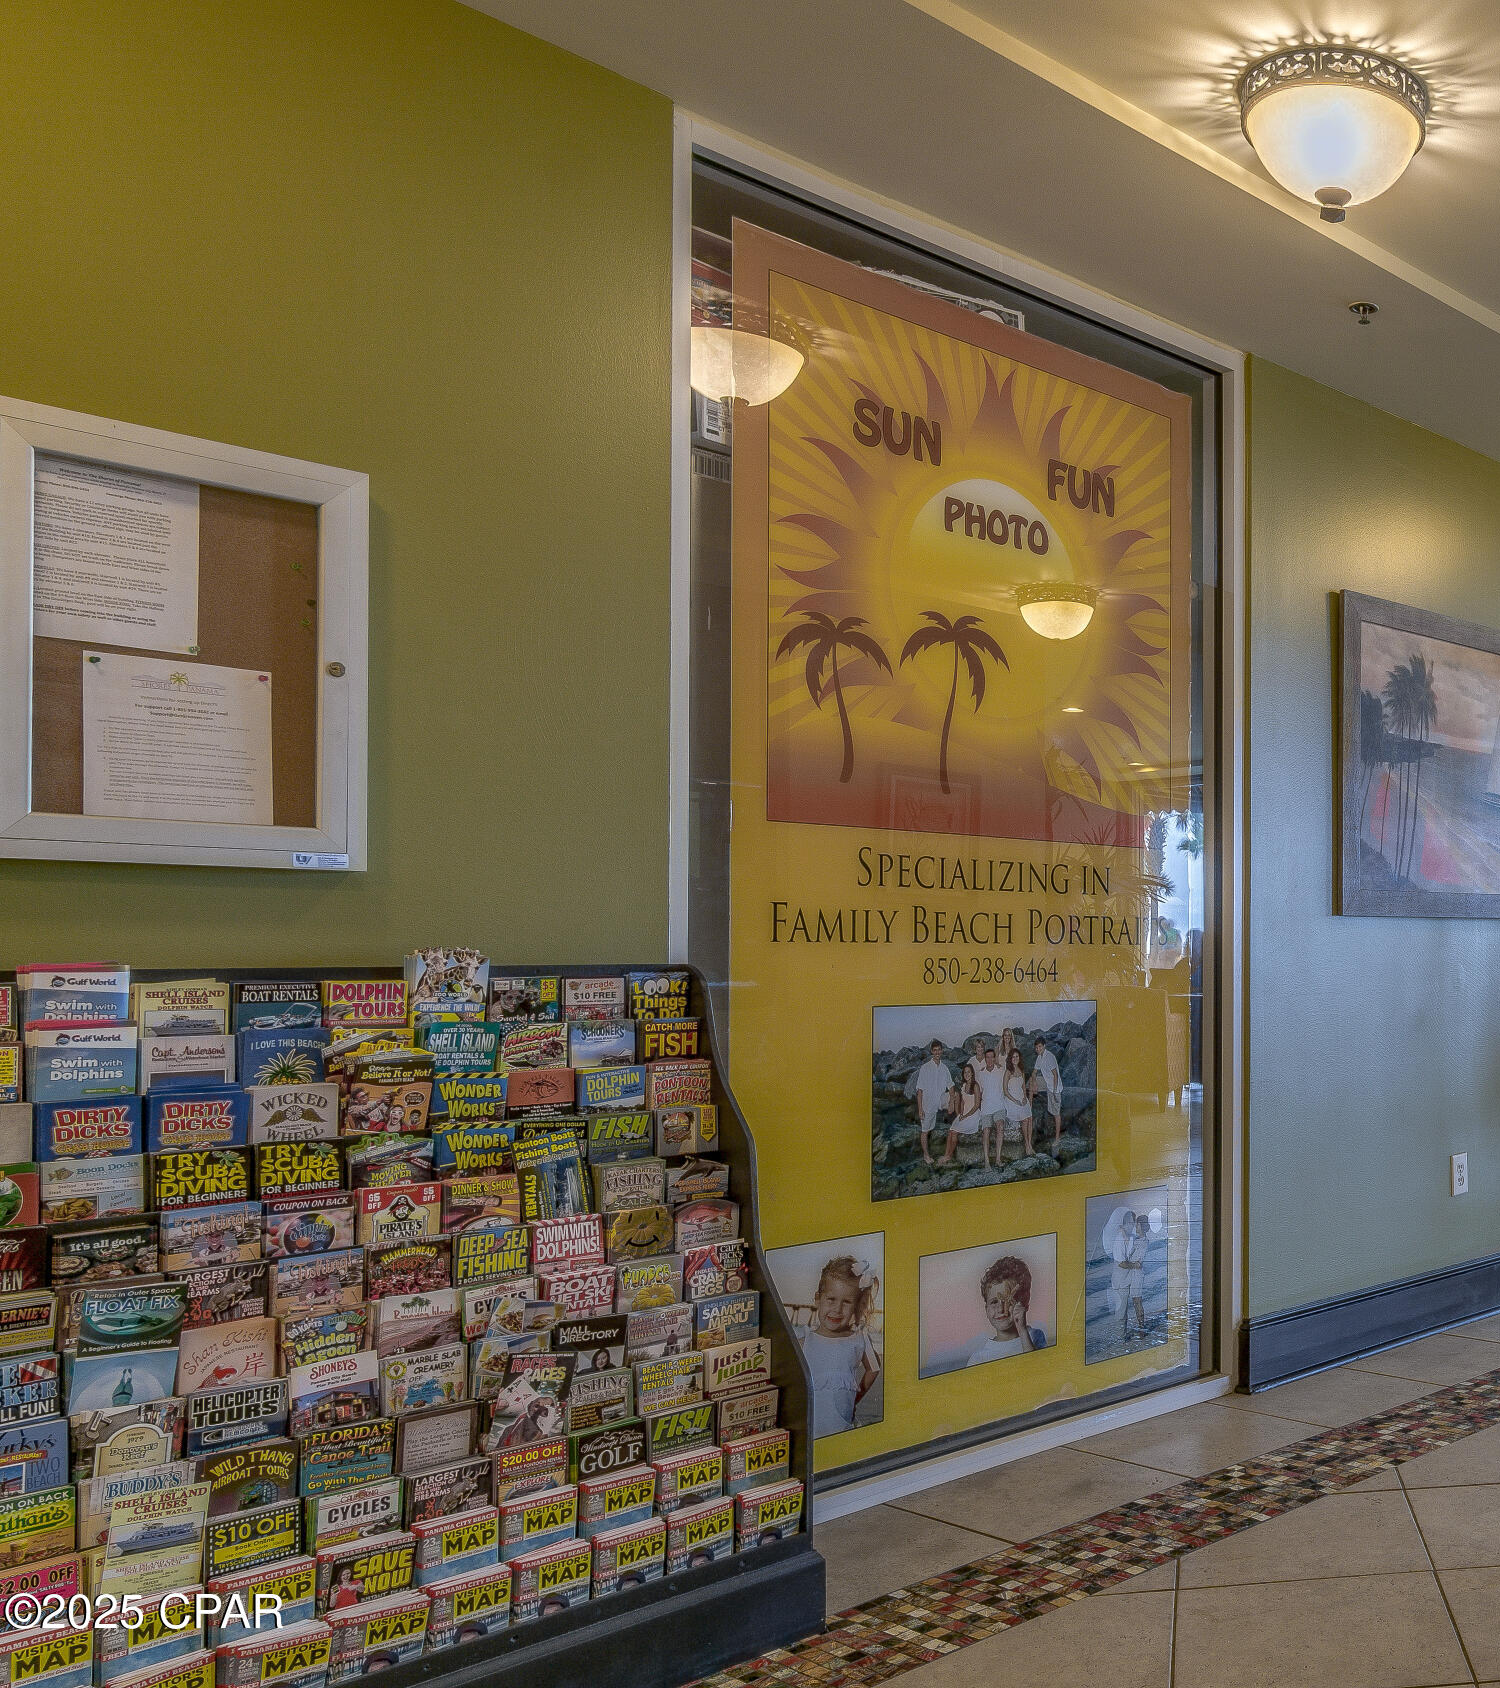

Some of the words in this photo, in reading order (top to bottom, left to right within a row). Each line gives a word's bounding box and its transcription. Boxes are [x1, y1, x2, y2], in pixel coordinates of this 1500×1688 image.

[852, 398, 943, 467] SUN
[1046, 458, 1117, 518] FUN
[943, 496, 1050, 556] PHOTO
[857, 846, 1070, 896] SPECIALIZING
[1081, 865, 1111, 897] IN
[770, 901, 899, 944] FAMILY
[911, 904, 1013, 946] BEACH
[1026, 908, 1168, 947] PORTRAITS
[922, 955, 1059, 985] 850-238-6464
[67, 978, 88, 986] Gulf
[88, 978, 117, 986] World
[332, 982, 406, 1001] DOLPHIN
[242, 991, 271, 1002] BOAT
[273, 990, 319, 1001] RENTALS
[352, 1001, 405, 1018] TOURS
[419, 1003, 452, 1012] EXPERIENCE
[453, 1003, 462, 1012] THE
[645, 1023, 673, 1032] CATCH
[674, 1022, 698, 1031] MORE
[255, 1040, 276, 1049] LOVE
[278, 1039, 295, 1048] THIS
[645, 1032, 698, 1057] FISH
[50, 1057, 98, 1068] Swim
[100, 1059, 123, 1067] with
[50, 1068, 124, 1082] Dolphins
[586, 1072, 640, 1091] DOLPHIN
[439, 1080, 502, 1101] WONDER
[587, 1087, 622, 1102] TOURS
[260, 1092, 328, 1112] WICKED
[447, 1100, 495, 1118] WORKS
[55, 1106, 129, 1127] DIRTY
[592, 1114, 650, 1140] FISH
[54, 1122, 131, 1143] DICKS
[513, 1137, 549, 1151] Pontoon
[550, 1130, 576, 1143] Boats
[161, 1151, 210, 1169] TRY
[515, 1148, 549, 1161] Fishing
[550, 1141, 577, 1152] Boats
[161, 1163, 247, 1183] SCUBA
[160, 1176, 247, 1198] DIVING
[161, 1196, 183, 1206] FOR
[187, 1190, 248, 1203] BEGINNERS
[273, 1200, 310, 1212] COUPON
[311, 1199, 323, 1209] ON
[325, 1197, 349, 1208] BACK
[379, 1219, 423, 1234] PIRATE'S
[383, 1230, 418, 1240] ISLAND
[536, 1225, 563, 1244] SWIM
[563, 1221, 600, 1241] WITH
[70, 1243, 91, 1252] It's
[93, 1239, 110, 1249] all
[111, 1235, 146, 1250] good.
[459, 1233, 495, 1258] DEEP
[503, 1229, 528, 1250] SEA
[537, 1236, 600, 1261] DOLPHINS!
[457, 1249, 528, 1279] FISHING
[85, 1297, 147, 1316] FLOAT
[150, 1294, 181, 1311] FIX
[702, 1300, 756, 1320] SAMPLE
[559, 1325, 589, 1336] MALL
[708, 1313, 749, 1329] MENU
[559, 1328, 620, 1345] DIRECTORY
[406, 1354, 439, 1366] MARBLE
[442, 1349, 462, 1360] SLAB
[413, 1361, 456, 1374] CREAMERY
[642, 1364, 667, 1375] BEACH
[668, 1356, 703, 1371] POWERED
[309, 1358, 358, 1380] SHONEY'S
[642, 1366, 690, 1383] WHEELCHAIR
[642, 1378, 674, 1391] RENTALS
[193, 1384, 281, 1412] HELICOPTER
[191, 1400, 279, 1429] TOURS
[311, 1423, 393, 1447] FLORIDA'S
[209, 1455, 245, 1478] WILD
[249, 1449, 295, 1467] THANG
[310, 1450, 354, 1466] Canoe
[358, 1441, 391, 1457] Trail
[502, 1450, 539, 1468] $20.00
[542, 1444, 563, 1458] OFF
[580, 1441, 643, 1474] GOLF
[105, 1471, 183, 1500] BUDDY'S
[211, 1466, 256, 1491] AIRBOAT
[259, 1464, 290, 1480] TOURS
[115, 1496, 157, 1511] SHELL
[160, 1485, 208, 1504] ISLAND
[133, 1499, 188, 1515] CRUISES
[526, 1499, 574, 1517] VISITOR'S
[327, 1496, 391, 1523] CYCLES
[214, 1519, 250, 1547] $10
[257, 1512, 295, 1535] OFF
[424, 1523, 454, 1536] PANAMA
[455, 1520, 469, 1530] CITY
[470, 1512, 497, 1525] BEACH
[444, 1518, 496, 1540] VISITOR'S
[527, 1508, 573, 1533] MAP
[445, 1529, 496, 1556] MAP
[353, 1549, 414, 1580] SAVE
[364, 1566, 412, 1595] NOW
[14, 1633, 89, 1661] VISITOR'S
[16, 1643, 88, 1681] MAP
